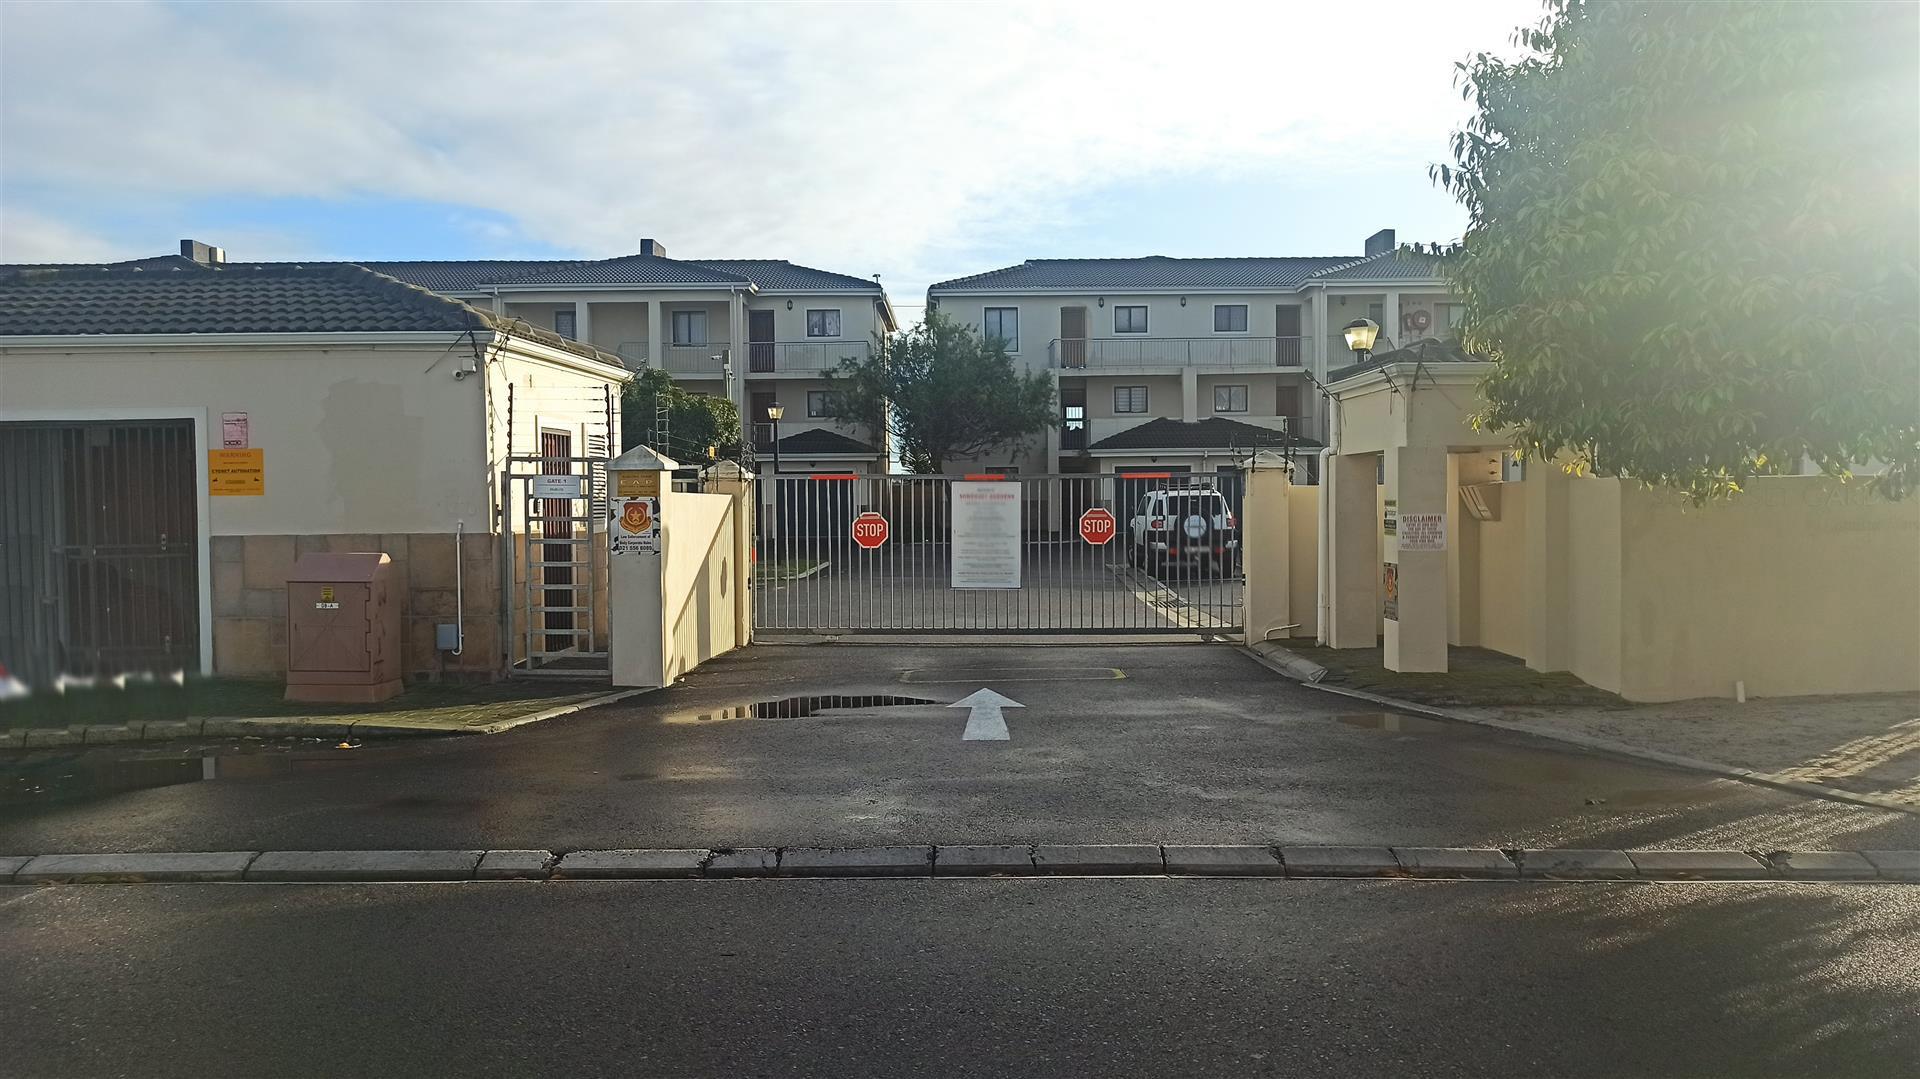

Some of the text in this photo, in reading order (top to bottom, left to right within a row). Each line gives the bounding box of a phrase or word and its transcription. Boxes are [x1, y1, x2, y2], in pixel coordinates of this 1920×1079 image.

[1084, 519, 1111, 533] STOP
[1402, 515, 1442, 523] DISCLAIMER
[857, 523, 884, 537] STOP
